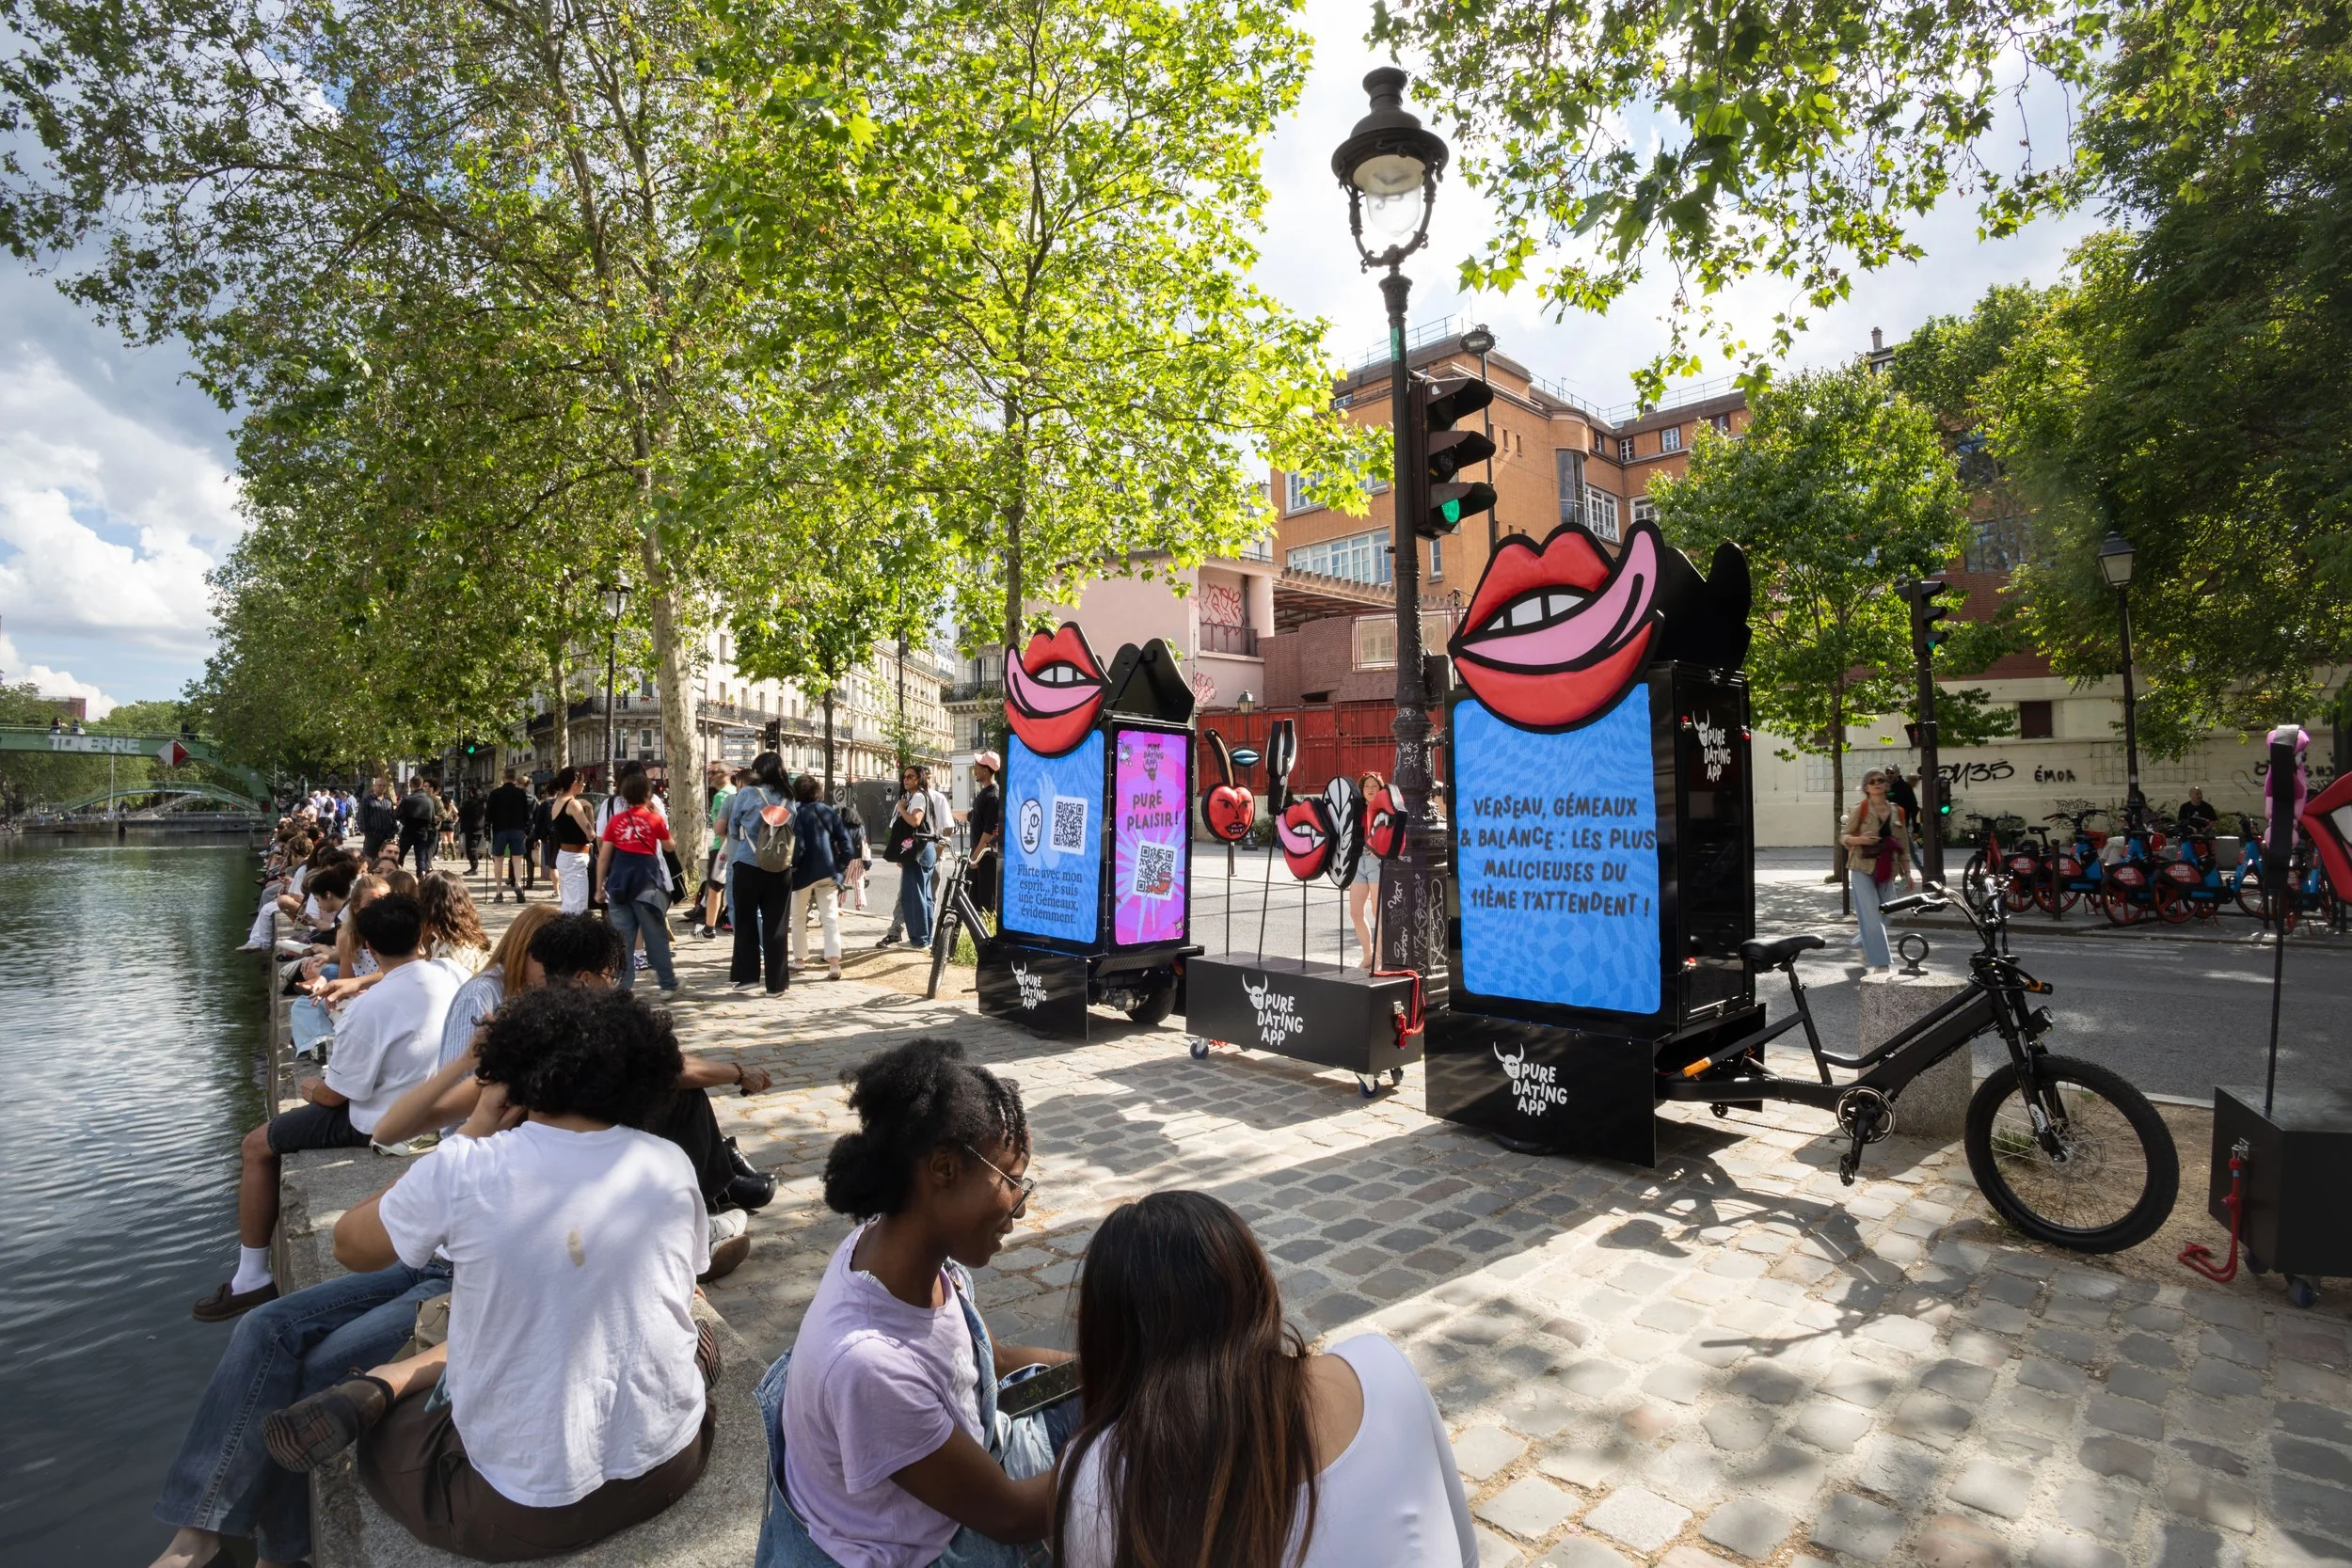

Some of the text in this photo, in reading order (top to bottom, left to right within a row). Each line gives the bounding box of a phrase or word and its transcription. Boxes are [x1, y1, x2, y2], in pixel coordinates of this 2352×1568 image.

[1708, 727, 1726, 746] PURE
[1144, 751, 1164, 760] DATING
[1704, 745, 1731, 765] DATING
[1707, 763, 1722, 783] APP
[1133, 790, 1162, 810] PURE
[1473, 792, 1638, 819] VERSEAU, GÉMEAUX
[1460, 828, 1471, 847] &
[1479, 827, 1554, 851] BALANCE
[1572, 828, 1602, 850] LES
[1610, 829, 1656, 850] PLUS
[1017, 863, 1083, 883] Flirte avec mon
[1484, 859, 1627, 882] MALICIEUSES DU
[1020, 879, 1078, 896] esprit... je suis
[1018, 893, 1079, 912] une Gémeaux,
[1470, 884, 1650, 917] 11ÈME T'ATTENDENT !
[1021, 904, 1076, 925] évidemment.
[1025, 974, 1041, 988] PURE
[1021, 985, 1047, 1002] DATING
[1023, 996, 1038, 1010] APP
[1264, 993, 1295, 1013] PURE
[1257, 1009, 1304, 1034] DATING
[1261, 1026, 1286, 1046] APP
[1520, 1063, 1557, 1084] PURE
[1512, 1079, 1567, 1104] DATING
[1518, 1096, 1547, 1117] APP
